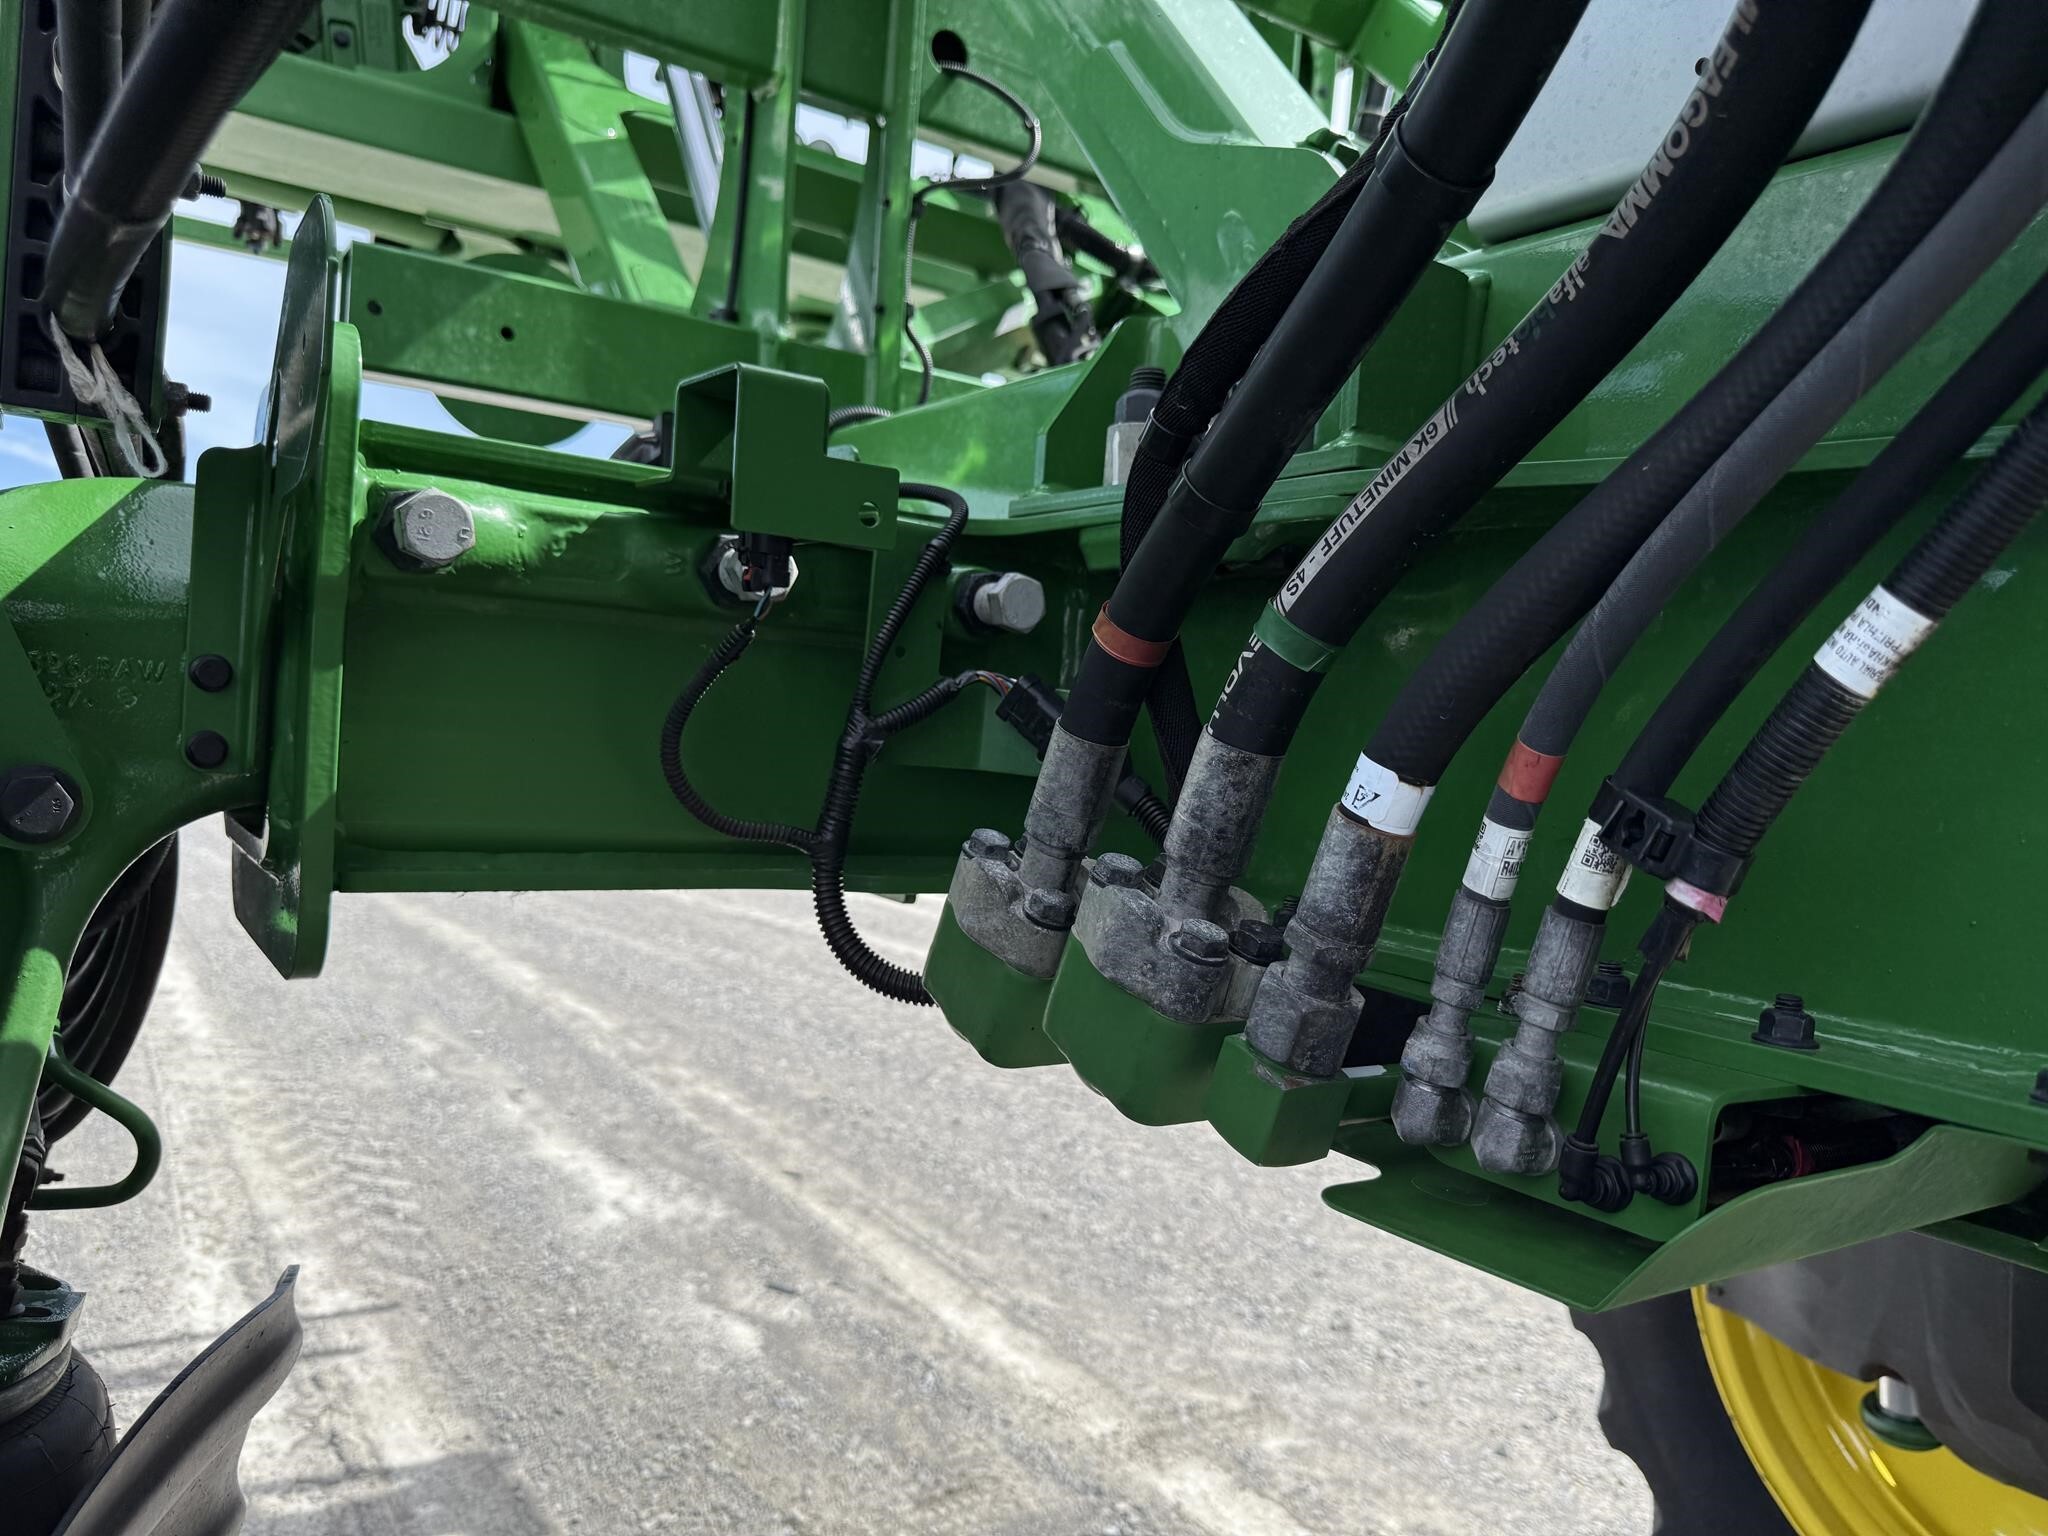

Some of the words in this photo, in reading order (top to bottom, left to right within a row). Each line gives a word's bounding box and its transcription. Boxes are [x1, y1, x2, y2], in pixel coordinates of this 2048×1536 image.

[1411, 425, 1439, 455] 6K
[1321, 450, 1412, 557] MINETUFF
[1285, 567, 1307, 597] 4S
